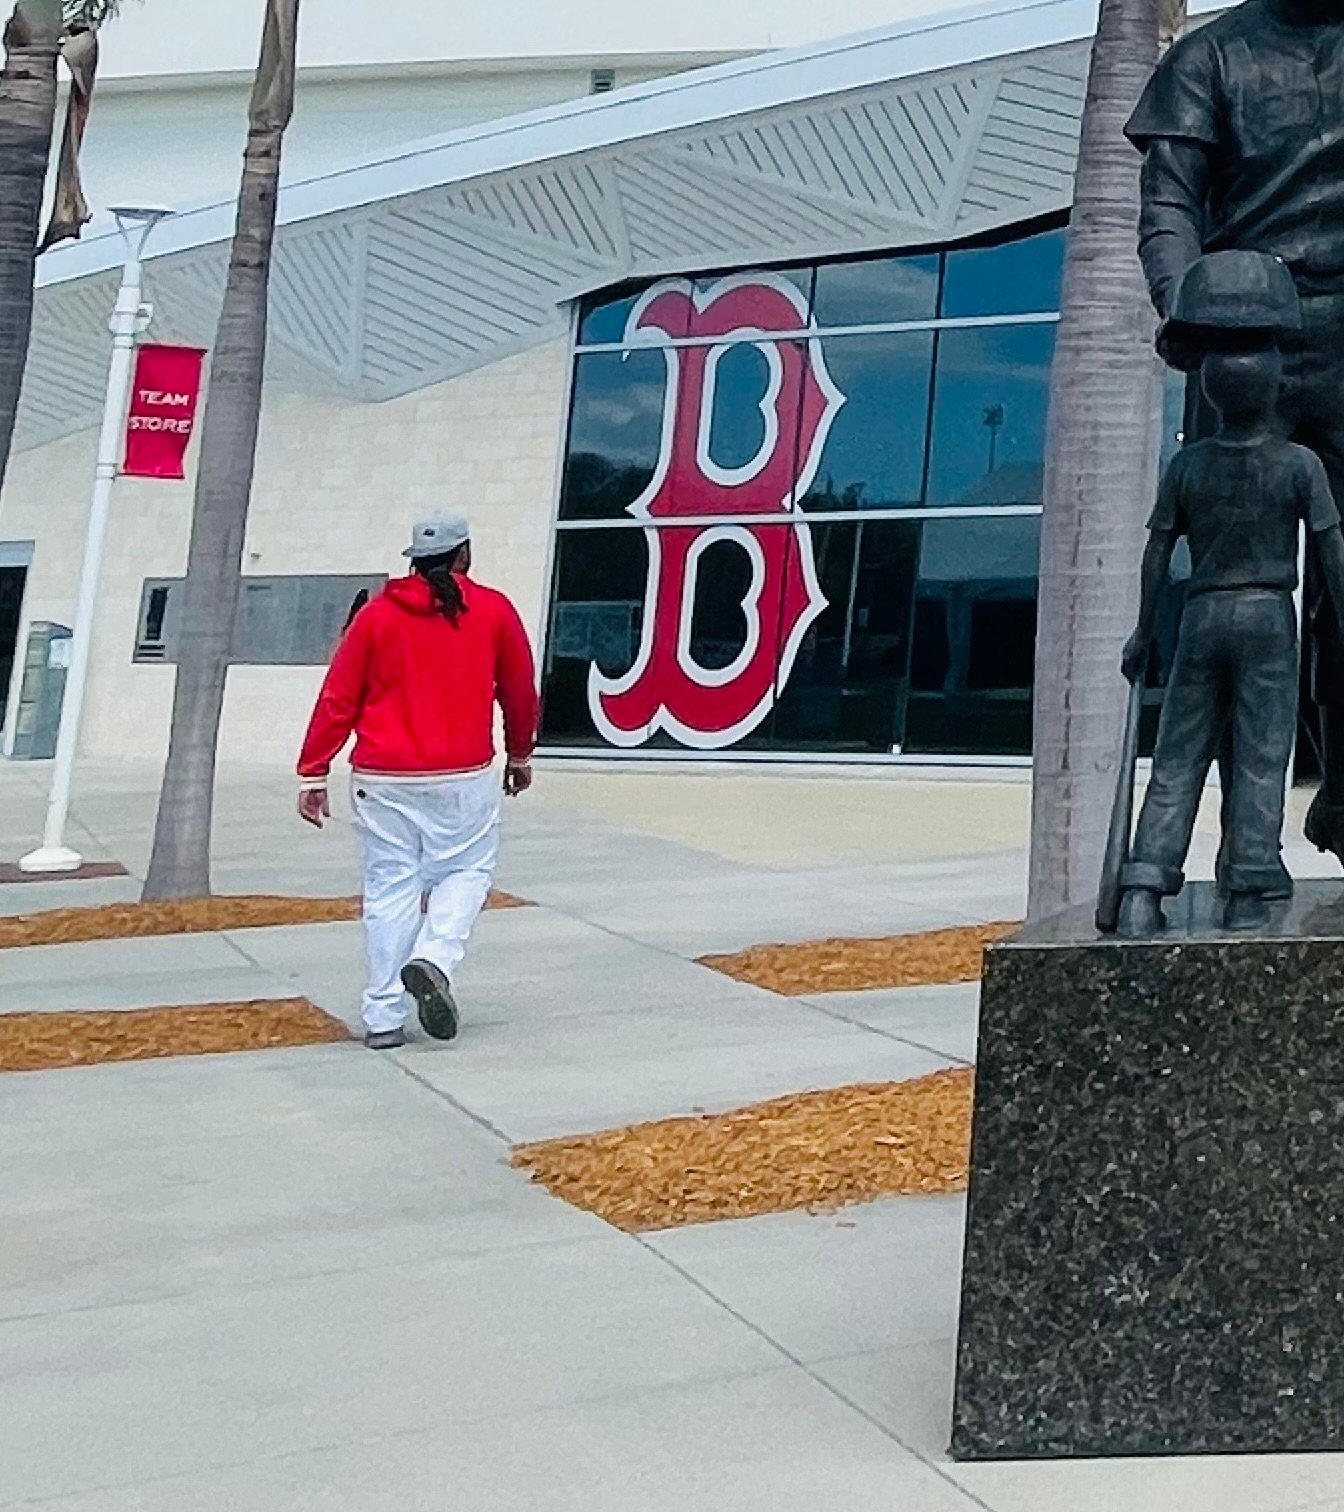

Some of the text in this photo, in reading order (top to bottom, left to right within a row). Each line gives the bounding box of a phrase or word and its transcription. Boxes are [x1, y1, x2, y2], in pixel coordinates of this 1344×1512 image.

[139, 390, 189, 406] TEAM
[129, 416, 191, 433] STORE
[588, 272, 848, 749] B
